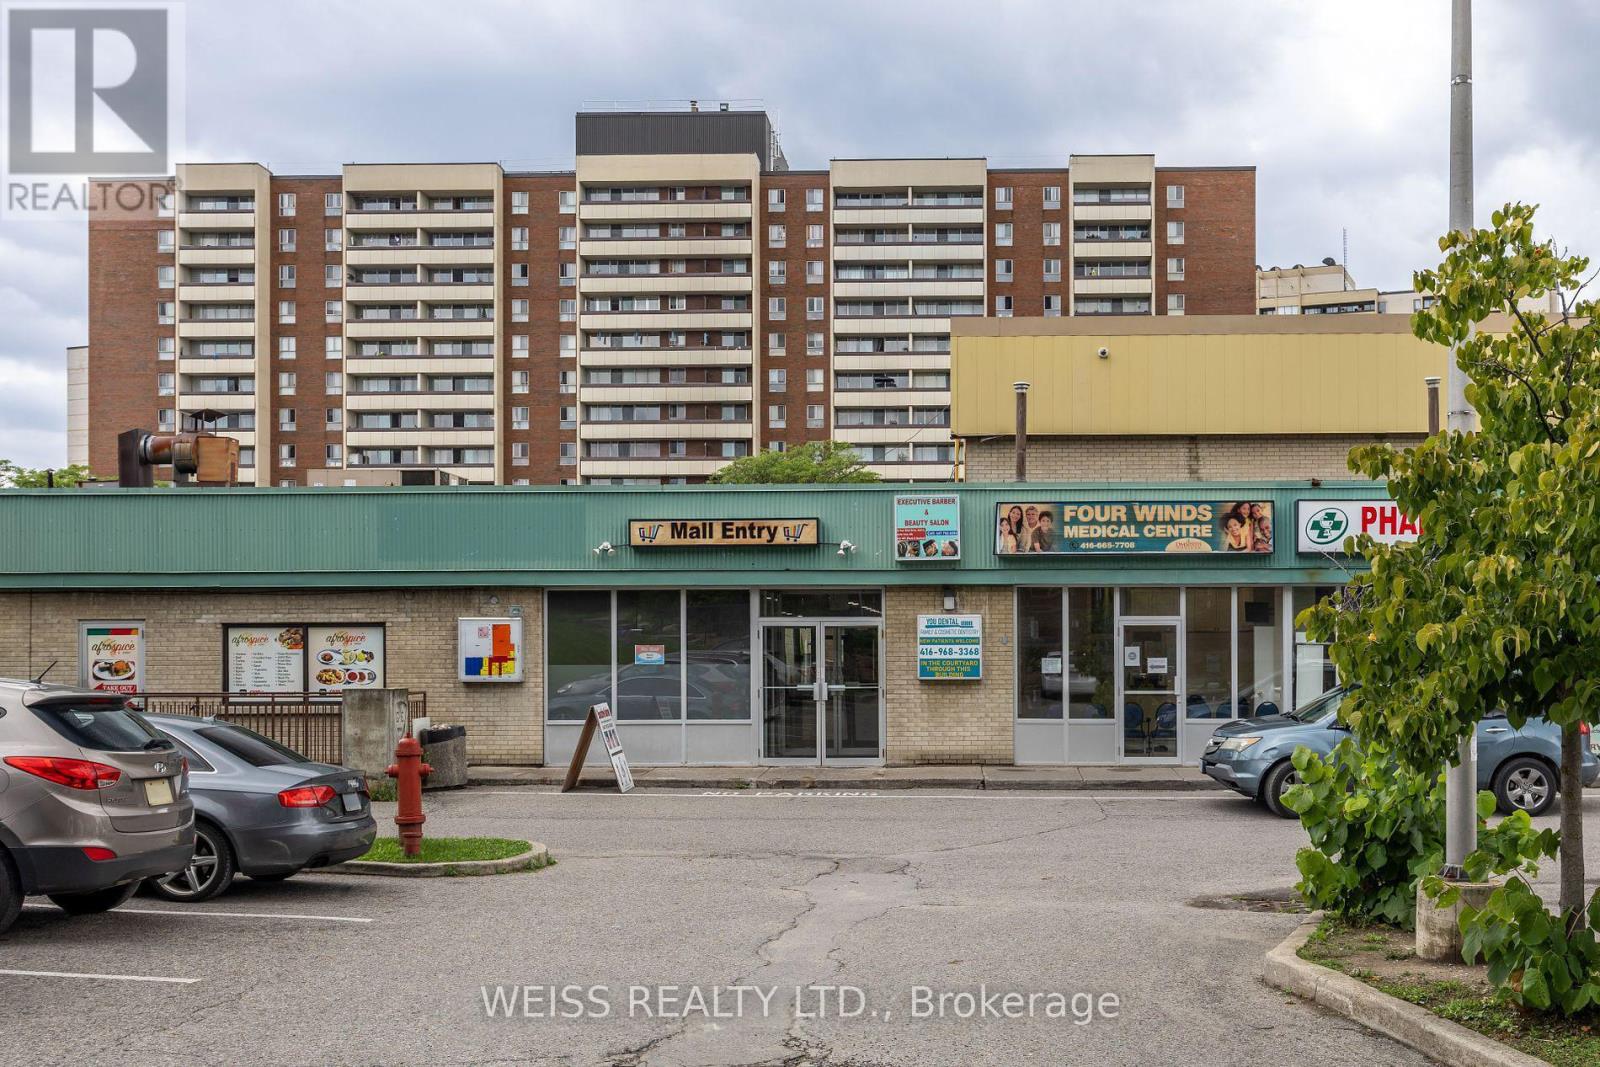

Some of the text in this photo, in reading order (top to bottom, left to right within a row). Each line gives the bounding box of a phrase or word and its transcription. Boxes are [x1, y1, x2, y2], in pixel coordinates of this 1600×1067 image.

[1063, 504, 1213, 522] FOUR WINDS
[670, 522, 779, 543] Mall Entry
[1063, 524, 1213, 538] MEDICAL CENTRE
